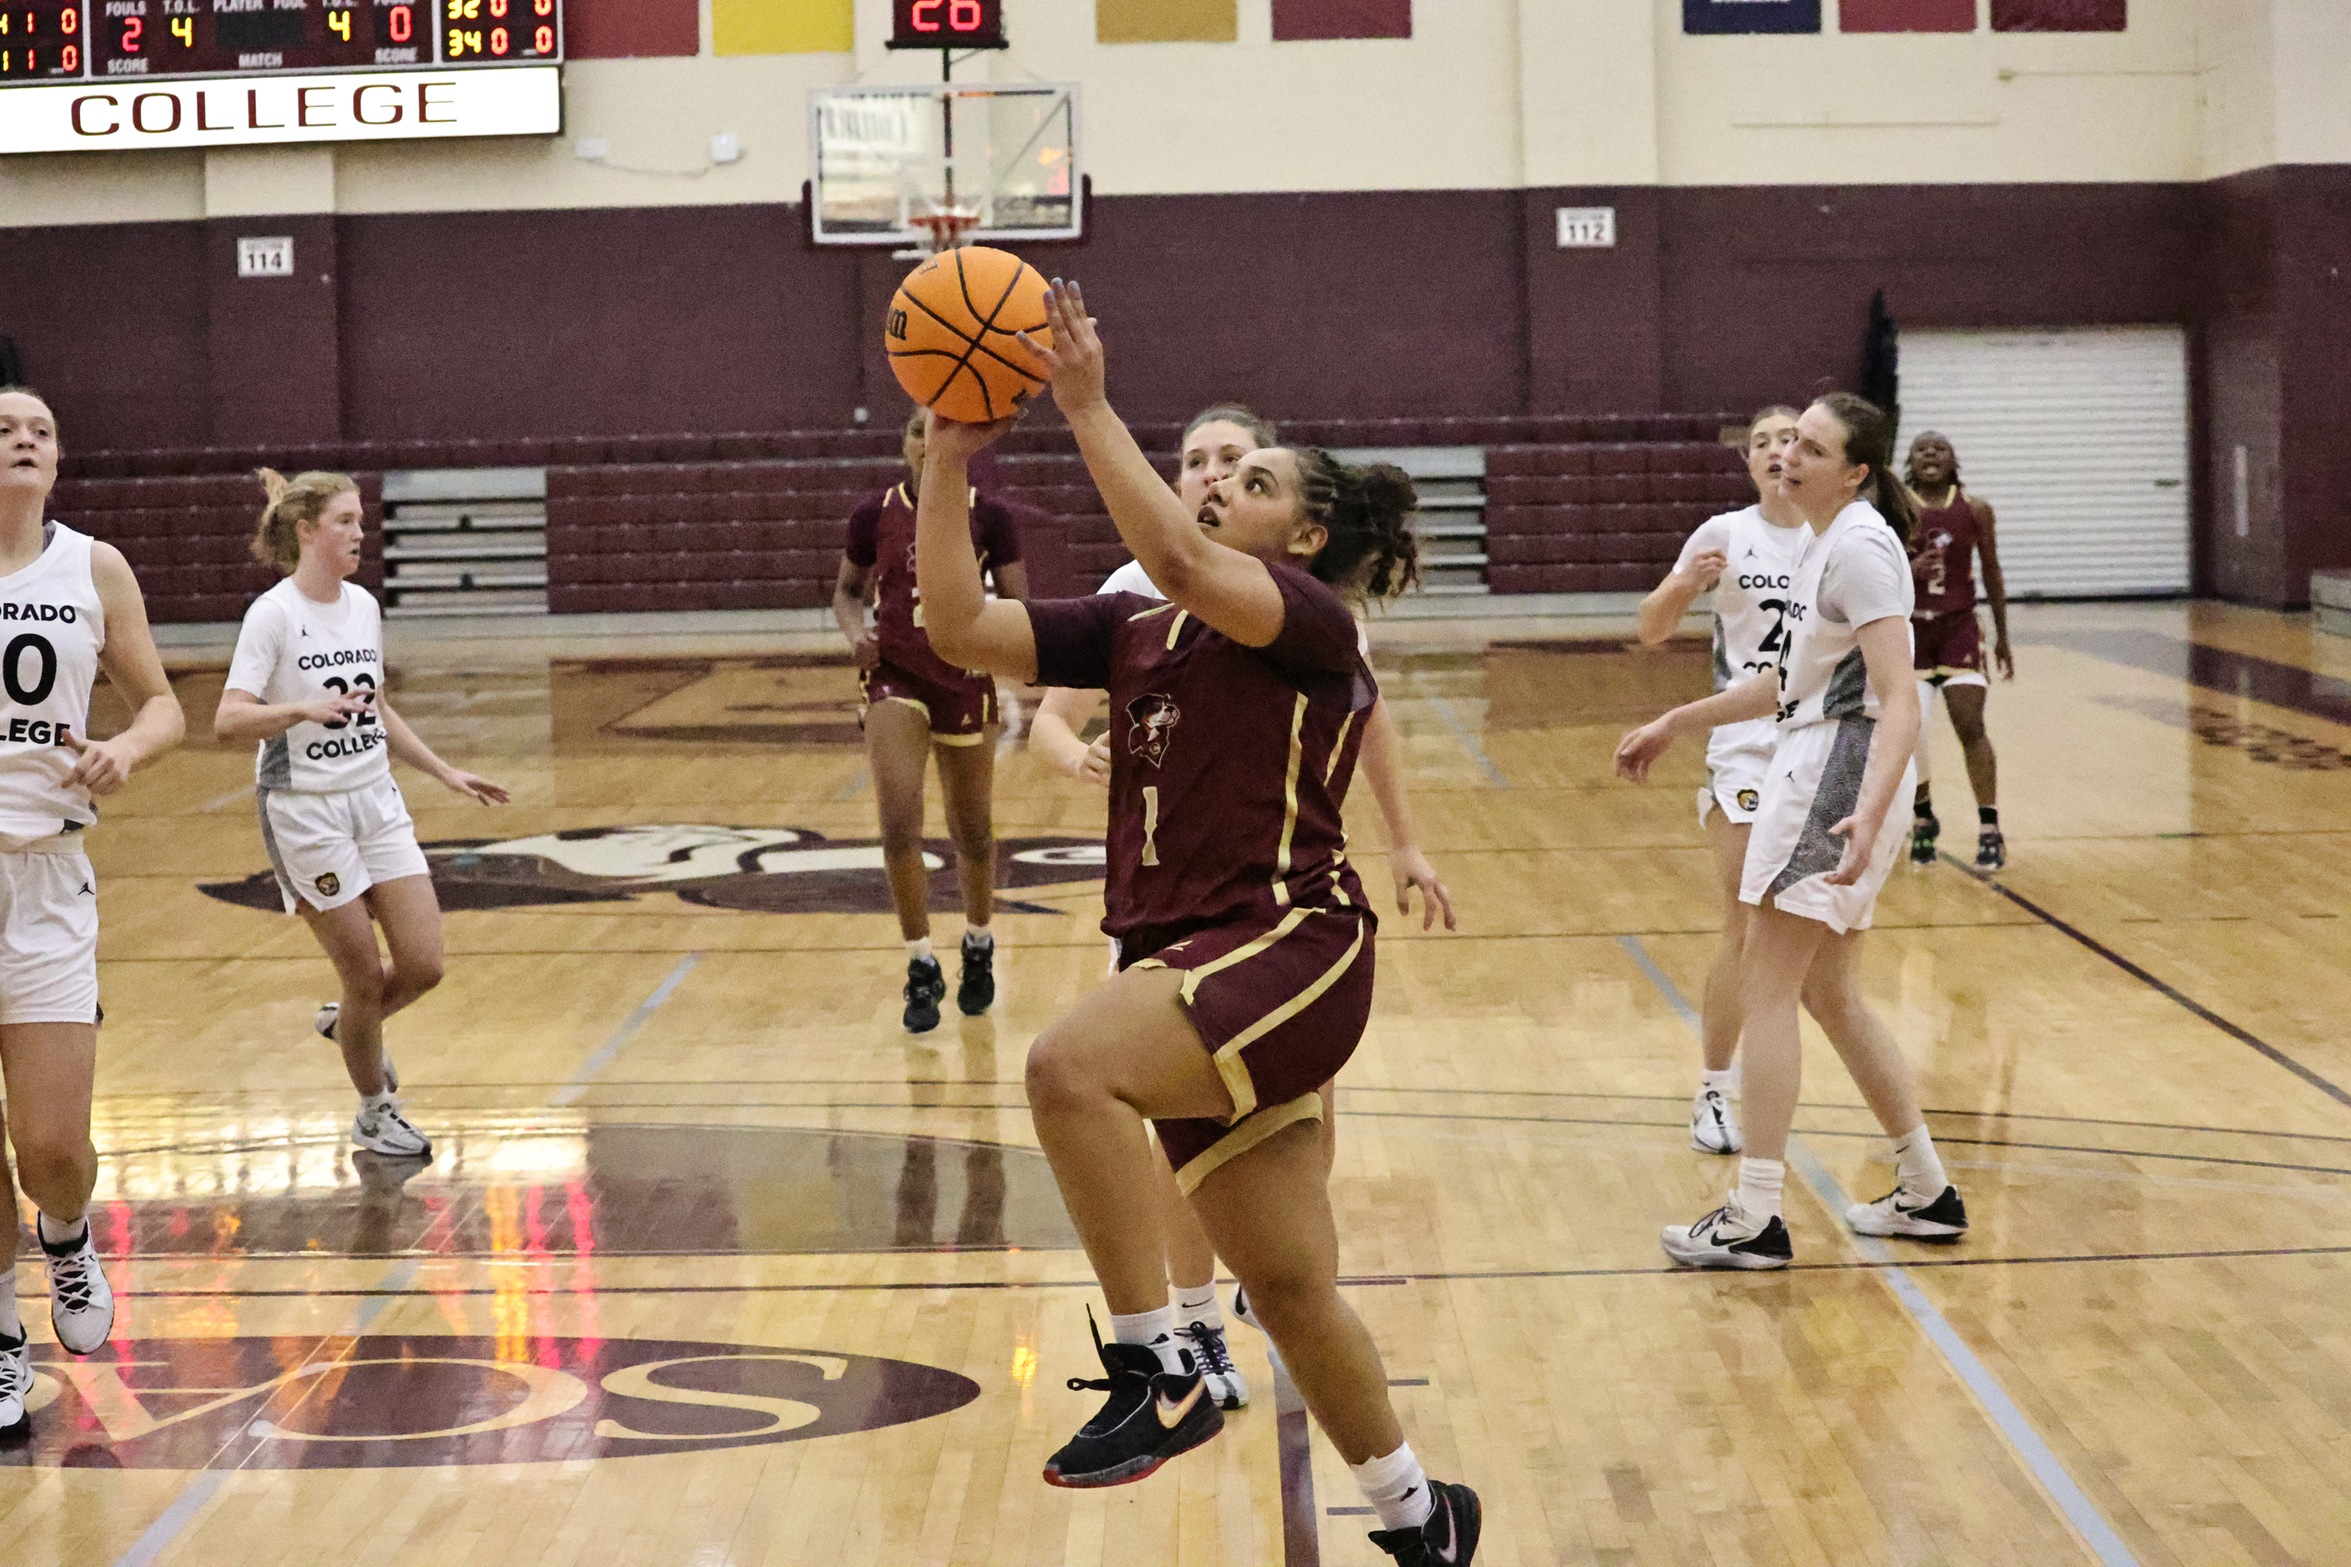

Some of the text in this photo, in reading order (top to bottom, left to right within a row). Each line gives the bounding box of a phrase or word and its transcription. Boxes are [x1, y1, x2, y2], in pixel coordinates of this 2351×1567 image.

[27, 11, 35, 34] 1
[61, 8, 77, 34] 0
[105, 1, 147, 17] FOULS
[121, 17, 143, 52] 2
[171, 17, 193, 48] 4
[328, 10, 351, 42] 4
[389, 5, 412, 43] 0
[448, 25, 553, 57] 34 0 0
[28, 48, 36, 71] 1
[62, 45, 78, 72] 0
[107, 58, 149, 74] SCORE
[238, 52, 283, 68] MATCH
[70, 82, 457, 136] COLLEGE
[1568, 222, 1605, 240] 112
[248, 252, 283, 270] 114
[1739, 574, 1790, 589] COLO
[0, 602, 76, 624] RADO
[3, 633, 57, 706] 0
[298, 648, 377, 671] COLORADO
[306, 727, 385, 760] COLLE
[1142, 786, 1160, 867] 1
[0, 1353, 850, 1442] SCA
